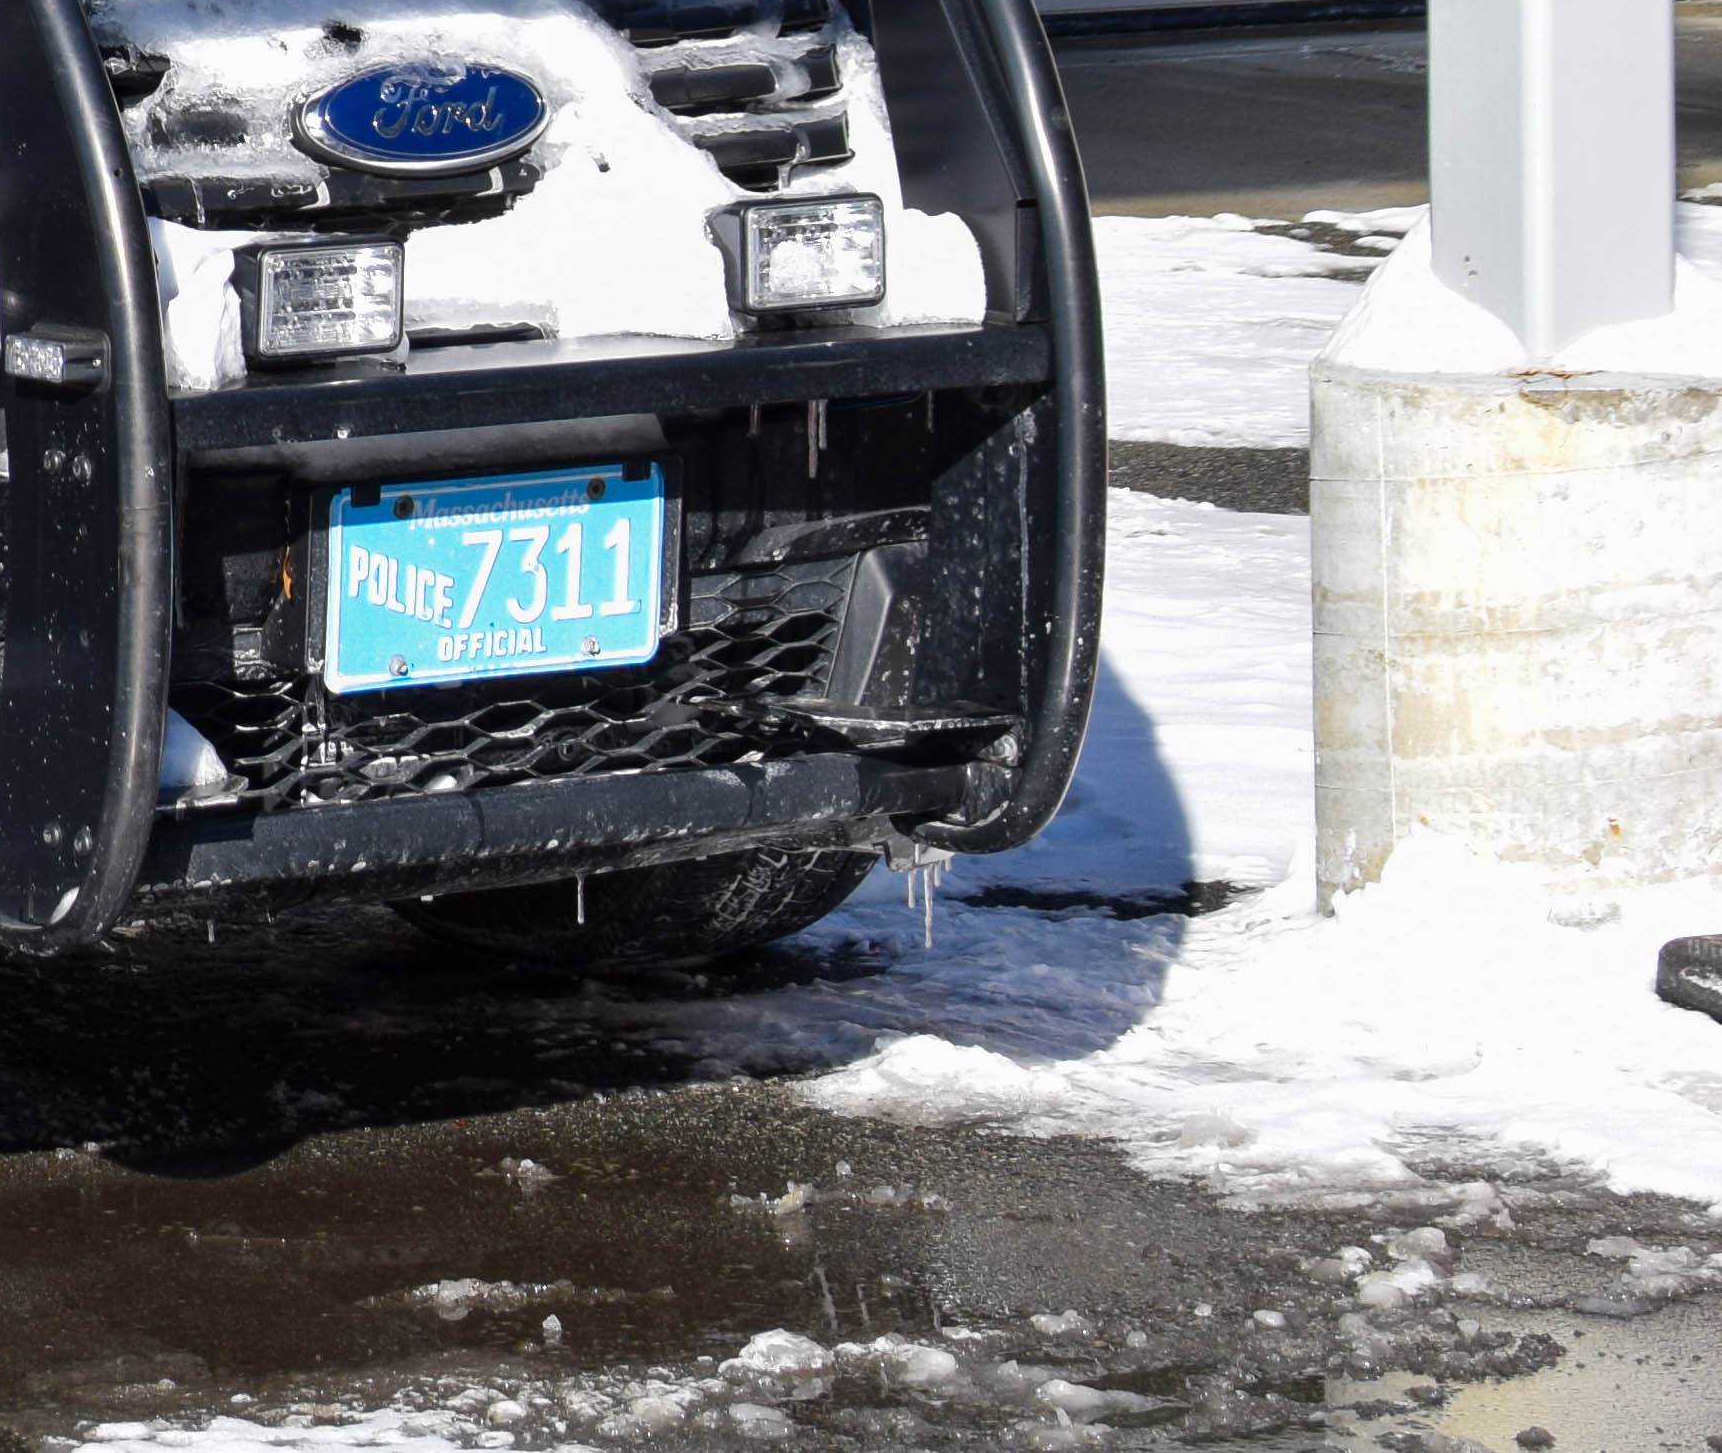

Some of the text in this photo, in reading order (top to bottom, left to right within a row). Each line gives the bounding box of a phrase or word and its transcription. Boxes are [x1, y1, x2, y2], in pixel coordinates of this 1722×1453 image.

[372, 76, 504, 139] Ford
[409, 489, 592, 532] Massachusetts
[348, 517, 642, 630] POLICE 7311
[437, 626, 548, 663] OFFICIAL
